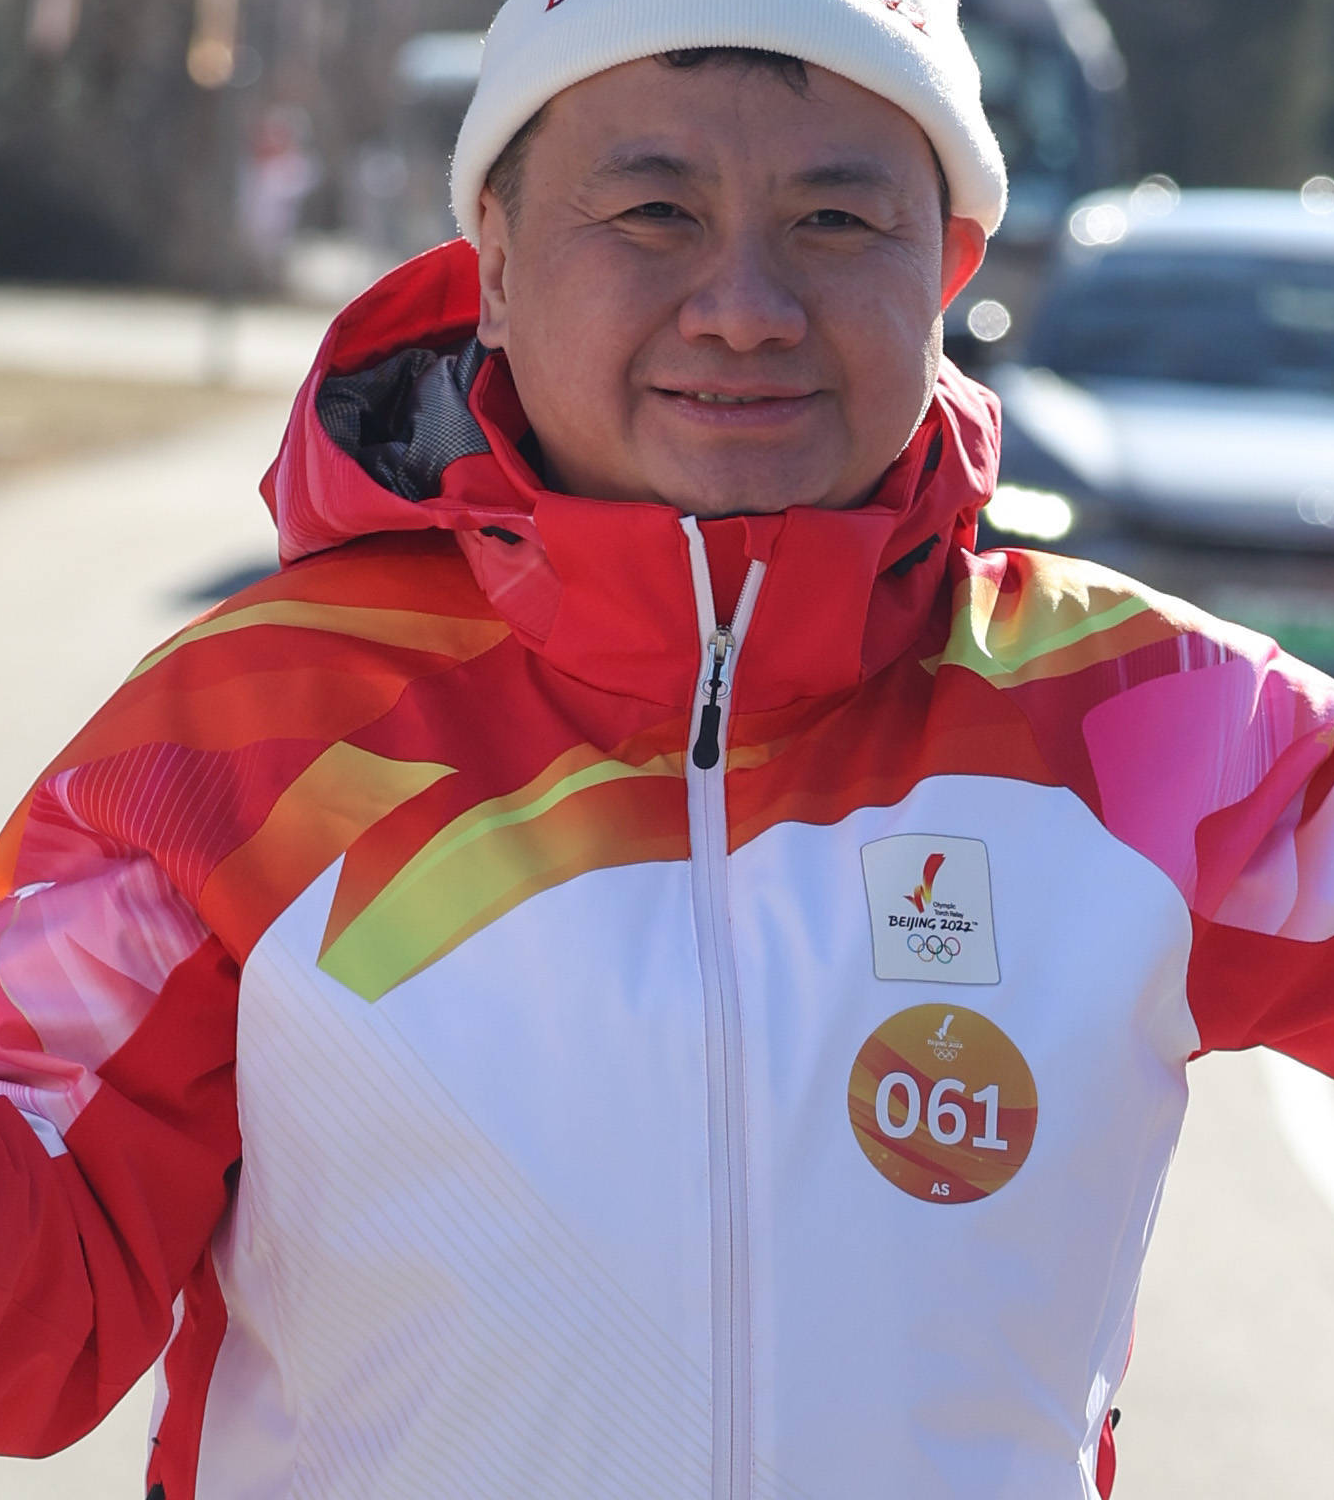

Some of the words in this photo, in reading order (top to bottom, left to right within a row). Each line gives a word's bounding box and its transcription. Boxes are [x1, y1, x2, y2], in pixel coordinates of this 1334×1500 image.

[932, 901, 956, 910] Olympic
[888, 915, 936, 931] BEIJING
[875, 1071, 1008, 1151] 061
[931, 1182, 950, 1196] AS
